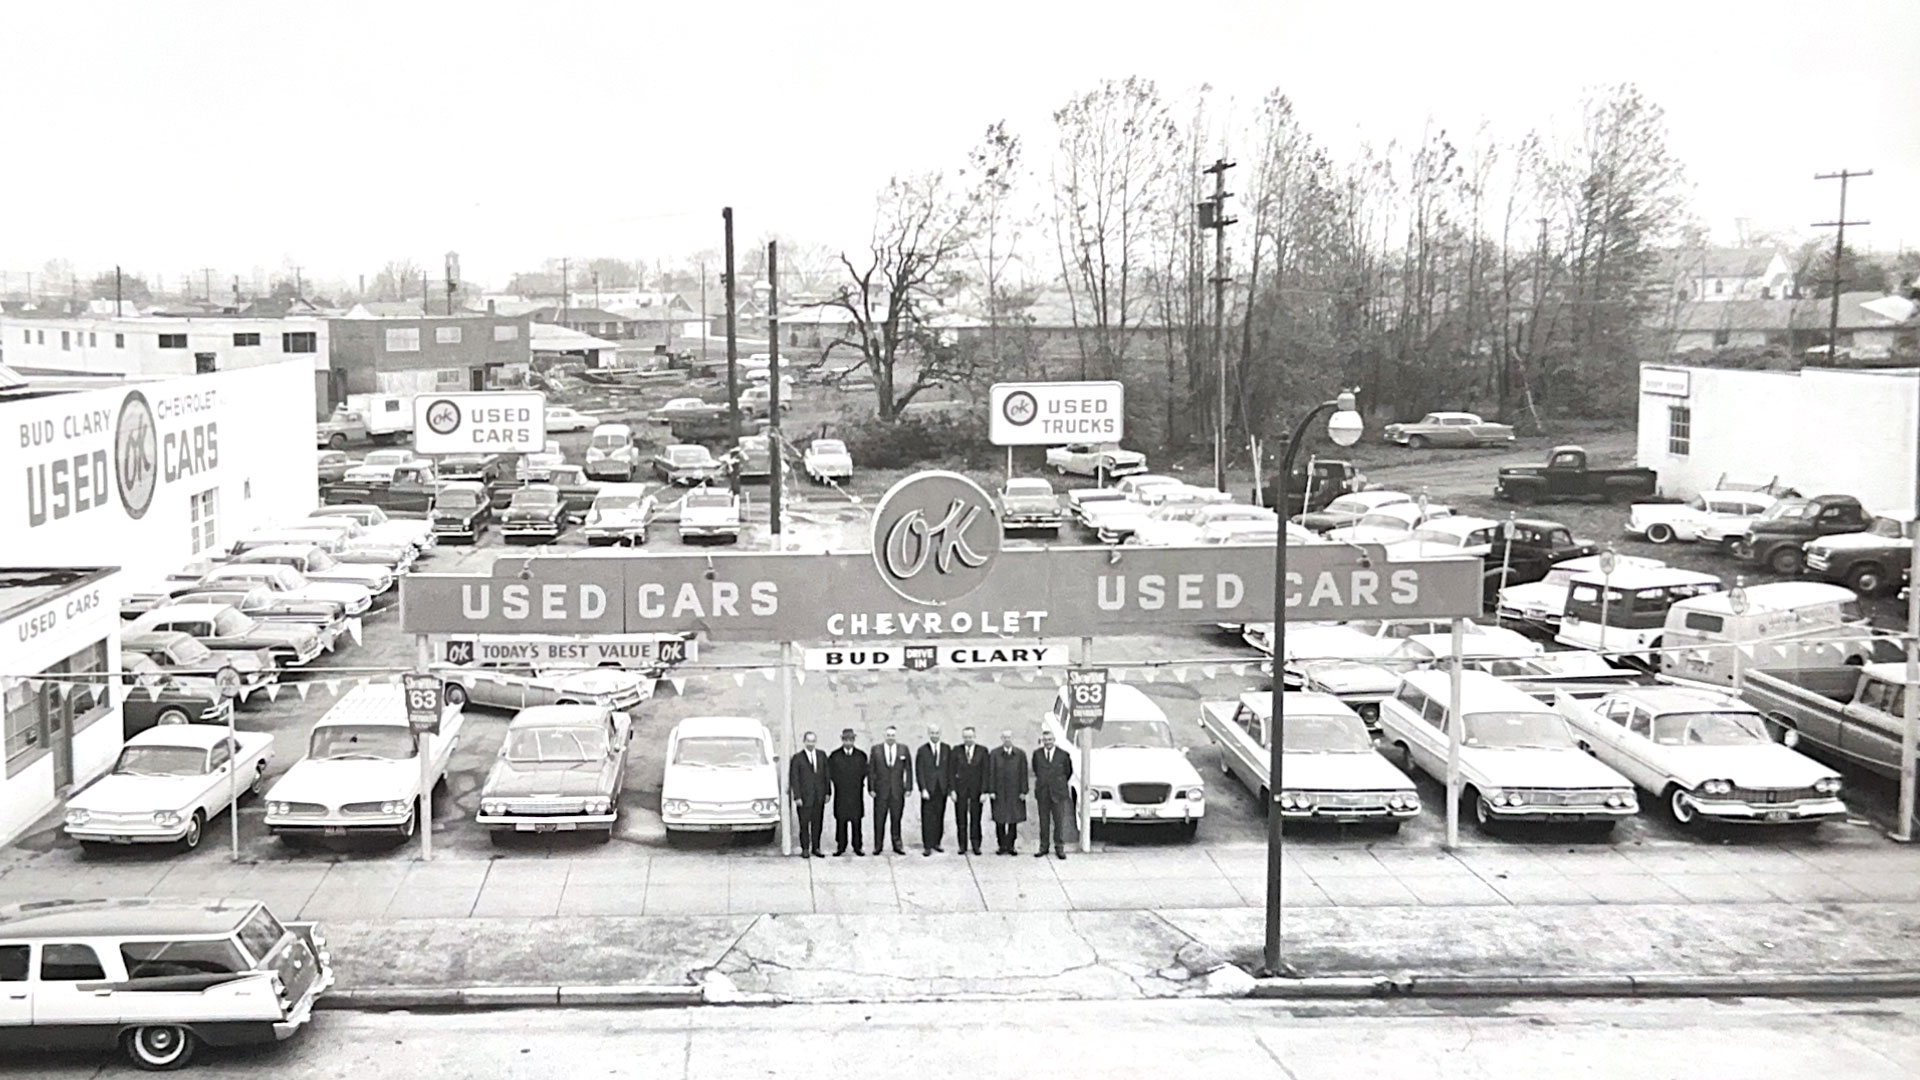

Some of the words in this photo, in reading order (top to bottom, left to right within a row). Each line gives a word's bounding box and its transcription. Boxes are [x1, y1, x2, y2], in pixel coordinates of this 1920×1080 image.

[158, 389, 217, 419] CHEVROLET
[1049, 399, 1108, 414] USED
[471, 407, 531, 424] USED
[20, 420, 54, 448] BUD
[63, 408, 112, 440] CLARY
[472, 428, 530, 443] CARS
[1042, 418, 1115, 434] TRUCKS
[124, 413, 151, 491] OK
[163, 421, 219, 484] CARS
[26, 448, 109, 528] USED
[886, 499, 987, 579] OK
[1097, 572, 1245, 611] USED
[1284, 569, 1419, 607] CARS
[462, 583, 607, 620] USED
[638, 581, 779, 618] CARS
[18, 610, 57, 643] USED
[66, 590, 100, 620] CARS
[826, 611, 1049, 636] CHEVROLET
[449, 643, 470, 662] OK
[481, 642, 540, 659] TODAY'S
[549, 644, 589, 659] BEST
[599, 644, 651, 658] VALUE
[660, 642, 682, 661] OK
[826, 651, 890, 665] BUD
[906, 648, 934, 659] DRIVE
[951, 648, 1049, 664] CLARY
[914, 658, 928, 669] IN
[1073, 683, 1102, 704] '63
